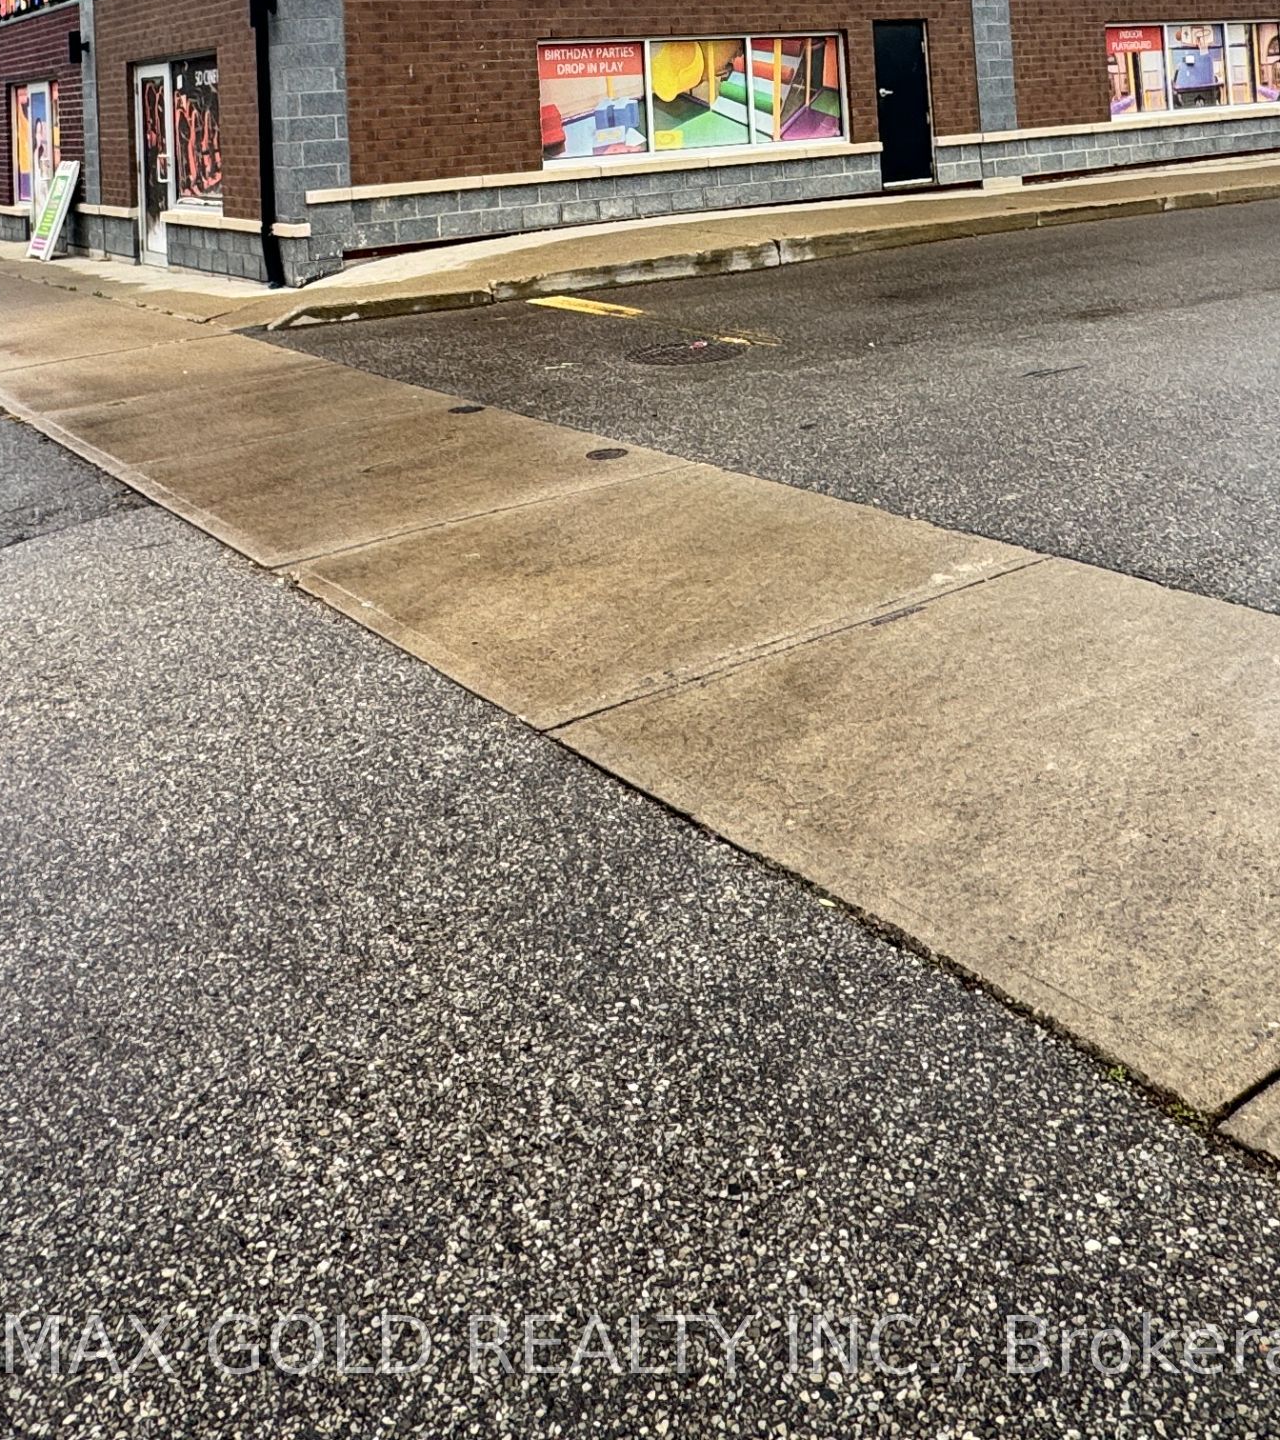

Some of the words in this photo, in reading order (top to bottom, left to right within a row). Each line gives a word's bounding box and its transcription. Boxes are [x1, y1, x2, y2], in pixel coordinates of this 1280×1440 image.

[544, 48, 594, 61] BIRTHDAY
[596, 46, 634, 59] PARTIES
[556, 63, 585, 75] DROP
[587, 62, 597, 74] IN
[598, 61, 624, 73] PLAY
